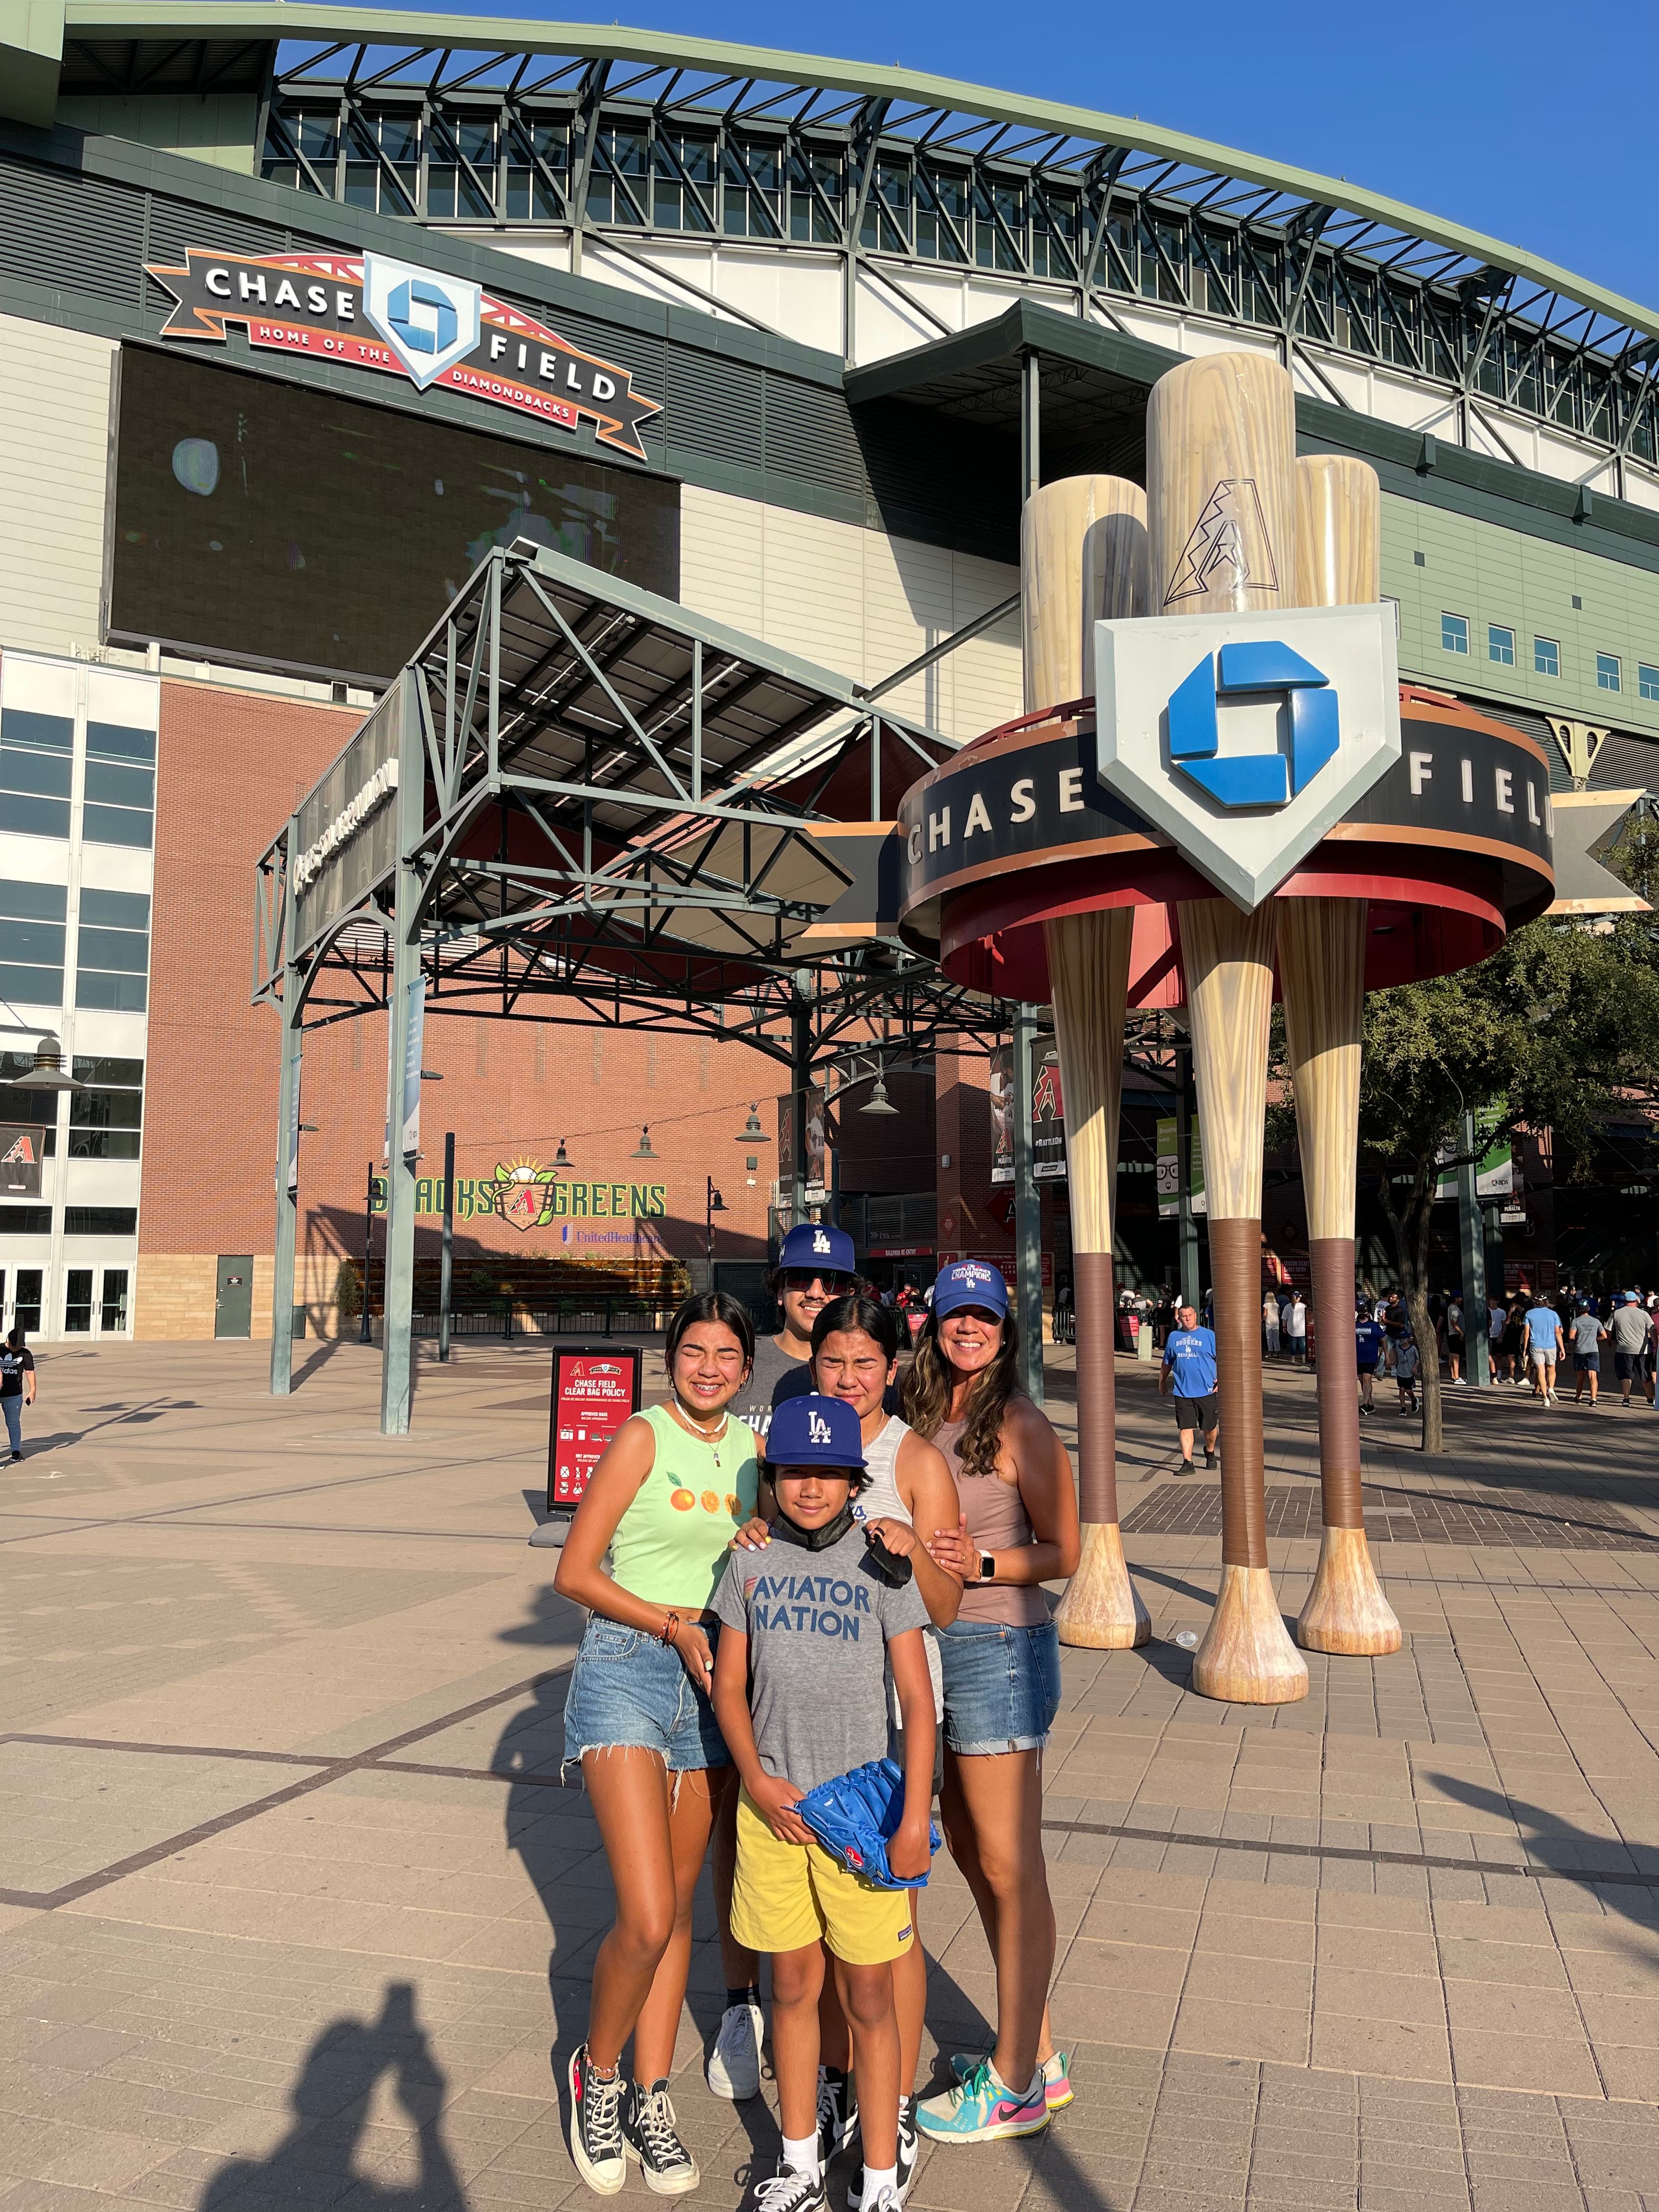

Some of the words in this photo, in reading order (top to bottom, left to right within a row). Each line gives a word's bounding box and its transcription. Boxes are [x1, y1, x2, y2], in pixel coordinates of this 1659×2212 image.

[205, 268, 355, 320] CHASE
[489, 334, 616, 402] FIELD
[259, 326, 310, 347] HOME
[323, 338, 345, 352] OF
[358, 346, 390, 363] THE
[452, 371, 571, 418] DIAMONDBACKS
[907, 766, 1085, 865] CHASE
[1410, 752, 1554, 838] FIELD
[997, 1156, 1013, 1165] MARTE
[553, 1181, 666, 1218] GREENS
[576, 1230, 663, 1244] UnitedHealthcare
[812, 1229, 831, 1254] LA
[951, 1270, 992, 1282] CHAMPIONS
[966, 1277, 976, 1288] LA
[587, 1388, 601, 1396] BAG
[602, 1389, 626, 1397] POLICY
[598, 1380, 616, 1389] FIELD
[808, 1411, 831, 1444] LA
[752, 1575, 870, 1614] AVIATOR
[755, 1605, 860, 1641] NATION
